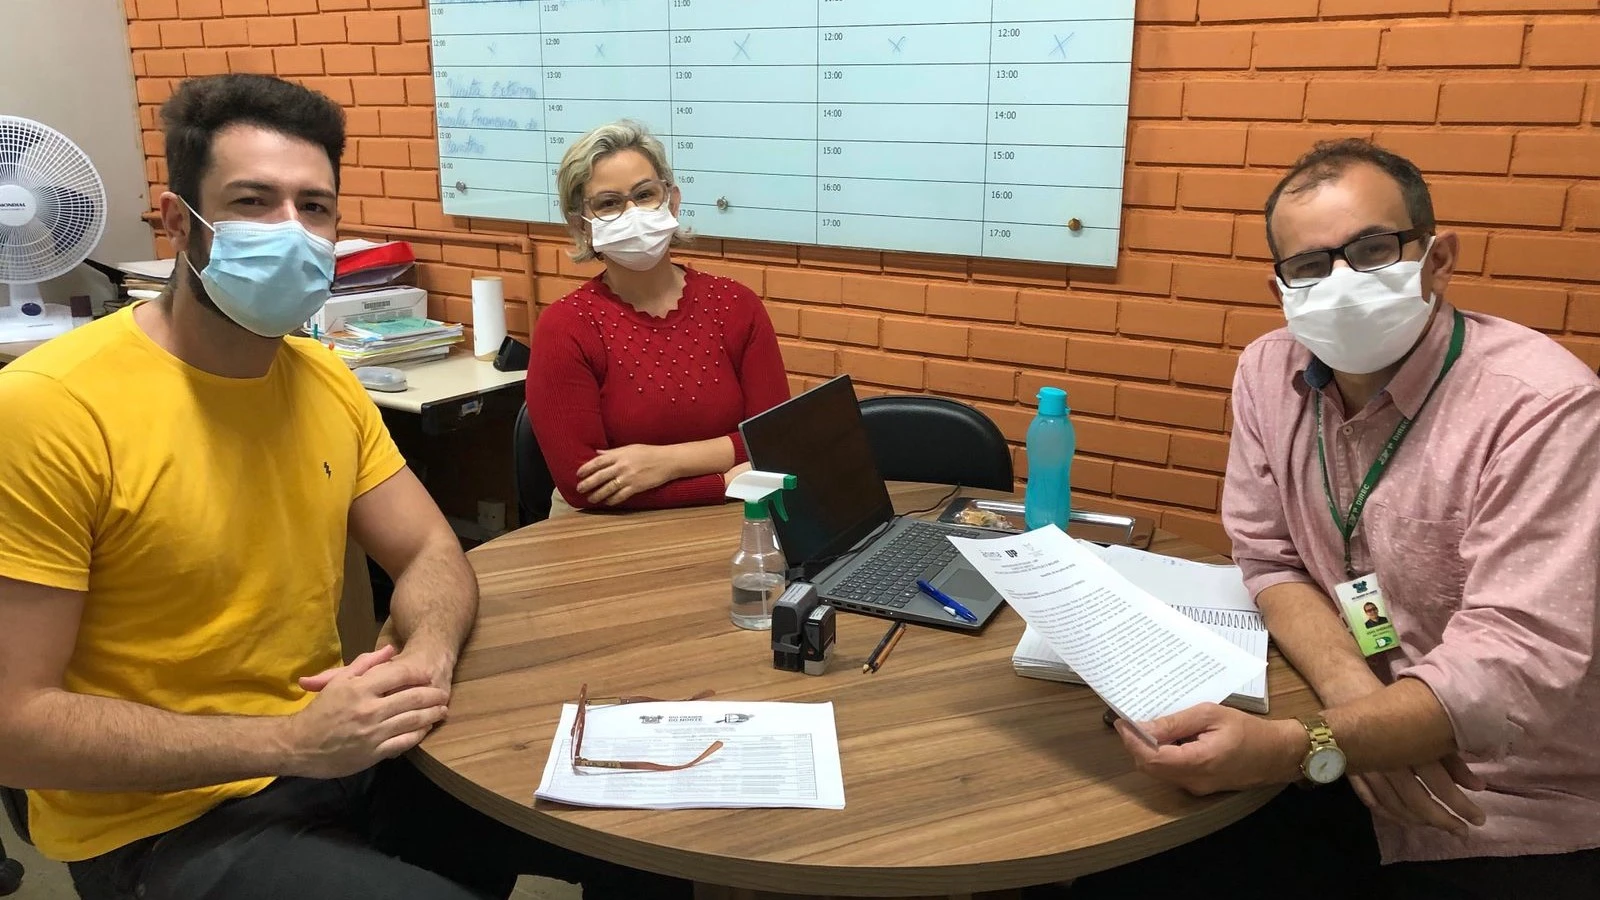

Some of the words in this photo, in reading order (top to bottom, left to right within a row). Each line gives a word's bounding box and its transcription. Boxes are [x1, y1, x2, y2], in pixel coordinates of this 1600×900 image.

[543, 4, 560, 12] 11:00
[673, 0, 692, 8] 11:00
[431, 8, 445, 16] 11:00
[823, 32, 844, 41] 12:00
[997, 28, 1021, 38] 12:00
[433, 39, 446, 47] 12:00
[545, 38, 561, 46] 12:00
[674, 35, 692, 44] 12:00
[434, 71, 448, 79] 13:00
[546, 71, 562, 79] 13:00
[675, 71, 693, 80] 13:00
[823, 70, 843, 80] 13:00
[996, 69, 1019, 79] 13:00
[437, 101, 450, 109] 14:00
[548, 104, 563, 112] 14:00
[676, 106, 693, 115] 14:00
[823, 108, 843, 118] 14:00
[994, 110, 1017, 120] 14:00
[439, 132, 452, 140] 15:00
[549, 136, 565, 145] 15:00
[677, 141, 694, 150] 15:00
[823, 146, 842, 155] 15:00
[992, 150, 1015, 160] 15:00
[441, 162, 454, 170] 16:00
[822, 183, 842, 192] 16:00
[990, 190, 1013, 200] 16:00
[822, 218, 841, 228] 17:00
[989, 228, 1011, 238] 17:00
[1355, 483, 1370, 506] DIREC
